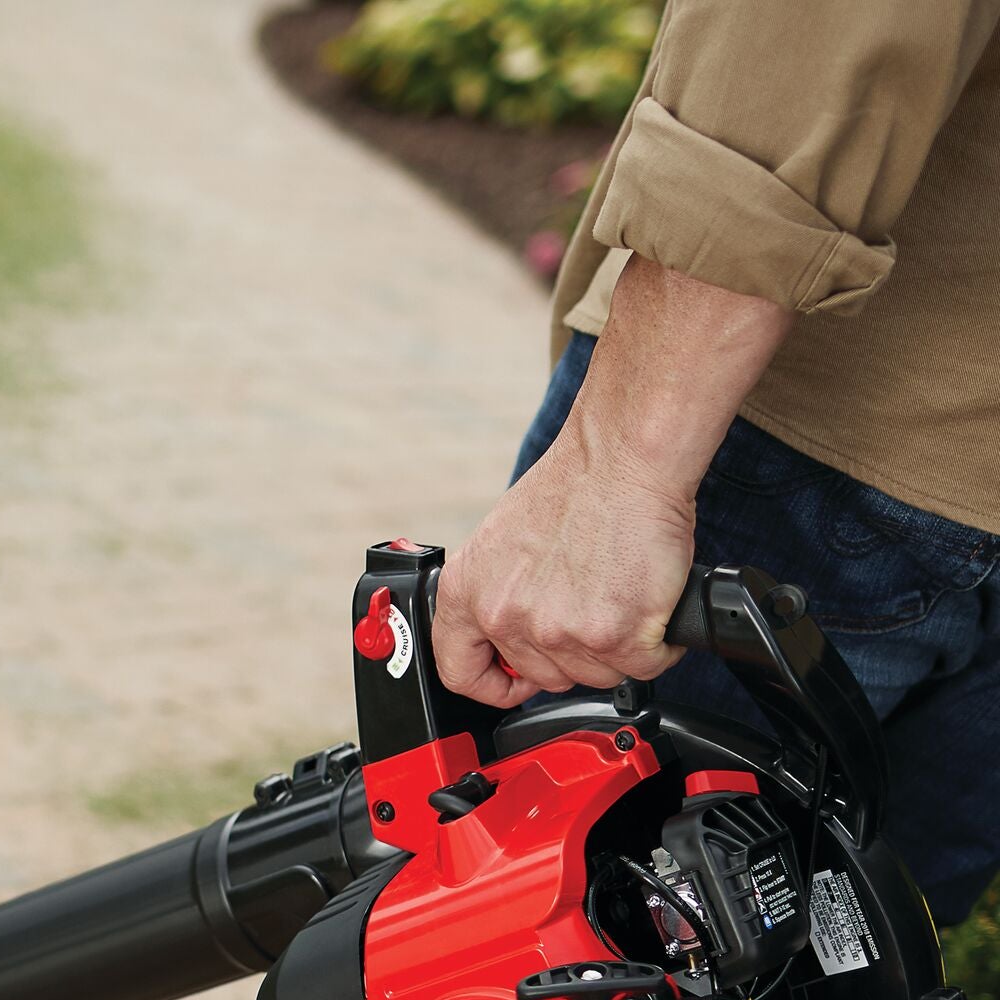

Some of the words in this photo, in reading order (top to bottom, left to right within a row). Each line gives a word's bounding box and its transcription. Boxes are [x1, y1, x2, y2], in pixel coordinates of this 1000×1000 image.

[398, 623, 409, 656] CRUISE
[840, 872, 855, 897] DESIGNED
[825, 901, 834, 916] LOWER
[833, 873, 850, 904] STANDARDS
[845, 903, 855, 915] AND
[850, 915, 863, 936] BEYOND
[850, 896, 859, 908] FOR
[854, 908, 865, 922] YEAR
[829, 926, 837, 936] THIS
[834, 936, 843, 951] ENGINE
[848, 926, 857, 942] ENGINE
[865, 934, 880, 959] EMISSION
[817, 936, 829, 958] EXTENDED
[830, 940, 843, 965] COMPLIANT
